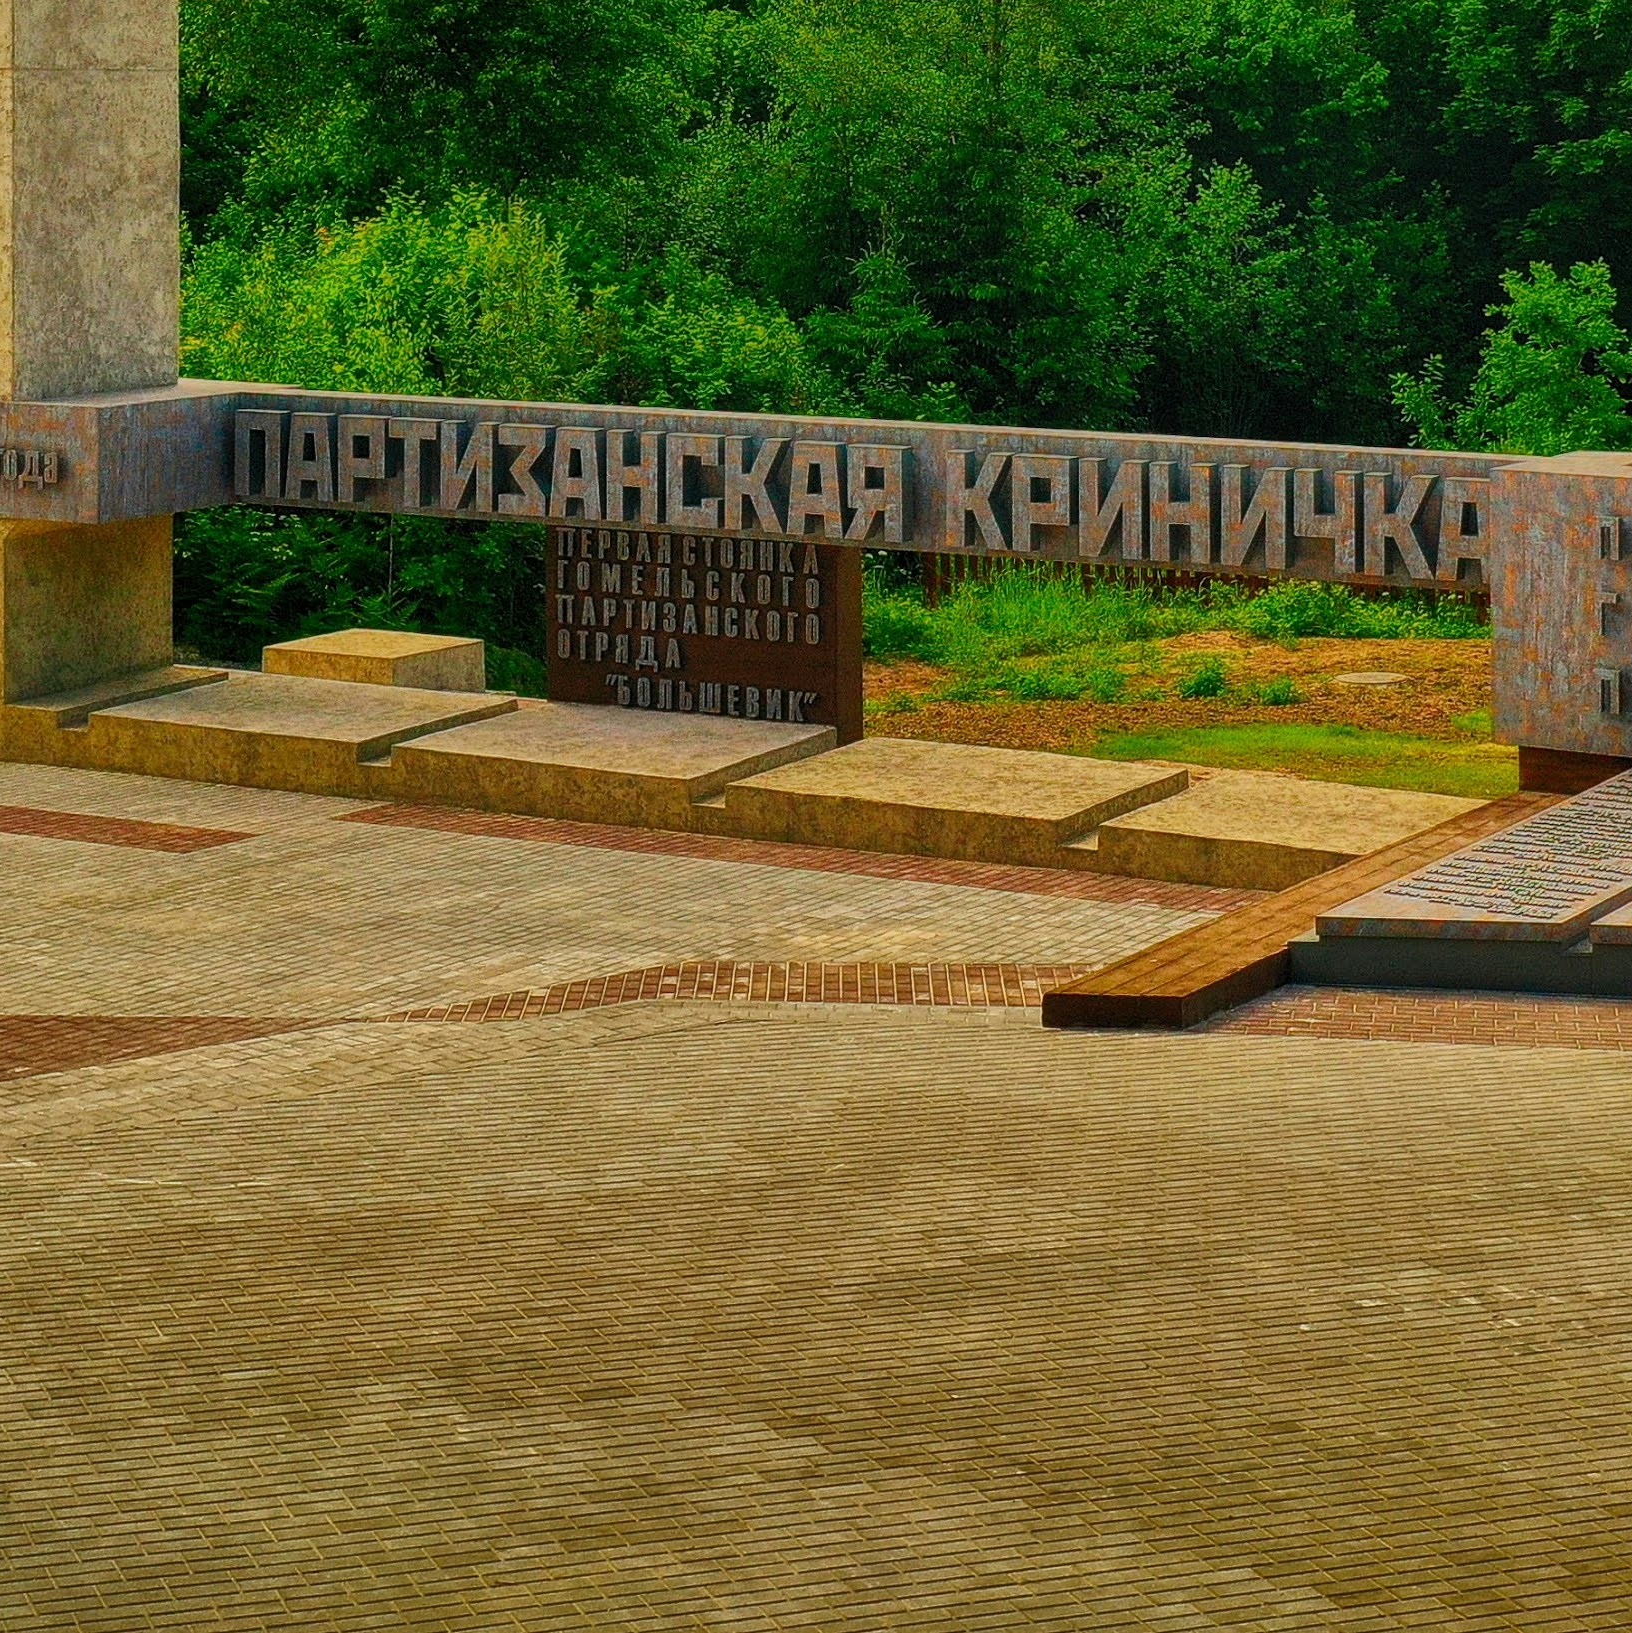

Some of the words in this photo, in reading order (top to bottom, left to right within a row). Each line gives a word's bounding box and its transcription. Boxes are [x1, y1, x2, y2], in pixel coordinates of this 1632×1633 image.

[234, 408, 911, 541] ПАРТИЗАНСКАЯ
[946, 449, 1490, 581] КРИНИЧКА
[555, 526, 672, 565] ПЕРВАЯ
[681, 535, 819, 575] СТОЯНКА
[556, 559, 820, 609] ГОМЕЛЬСКОГО
[555, 593, 820, 646] ПАРТИЗАНСКОГО
[556, 628, 682, 673] ОТРЯДА
